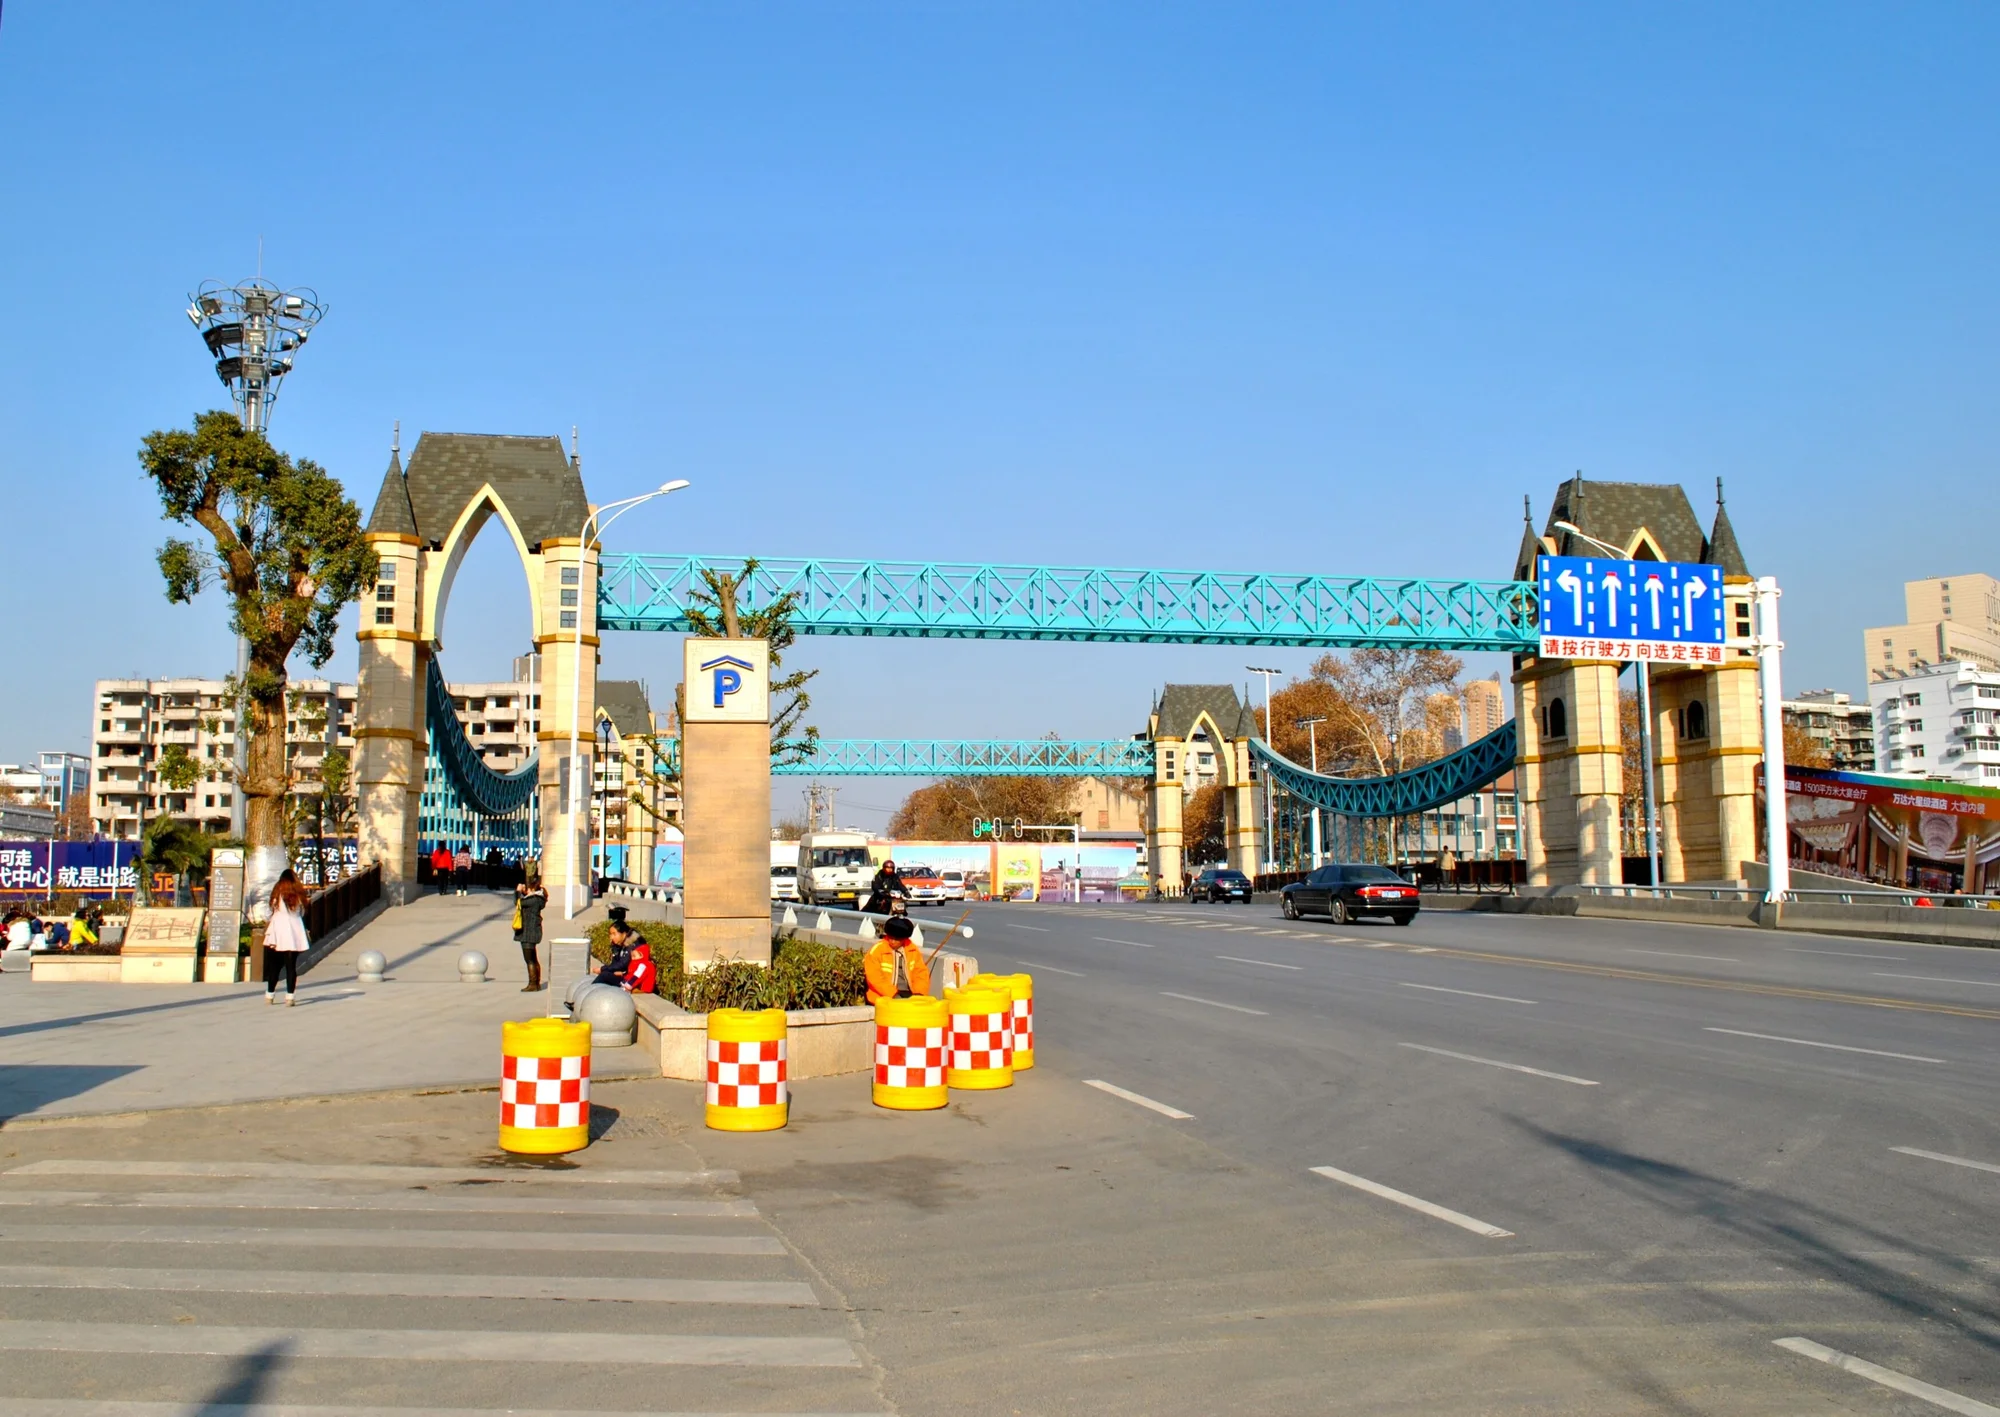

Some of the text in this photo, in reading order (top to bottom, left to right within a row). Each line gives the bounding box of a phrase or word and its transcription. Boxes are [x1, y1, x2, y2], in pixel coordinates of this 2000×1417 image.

[1544, 638, 1722, 662] 请按行驶方向选定车道
[714, 668, 742, 708] P
[1893, 793, 1986, 815] 万达六星级酒店 大堂内景
